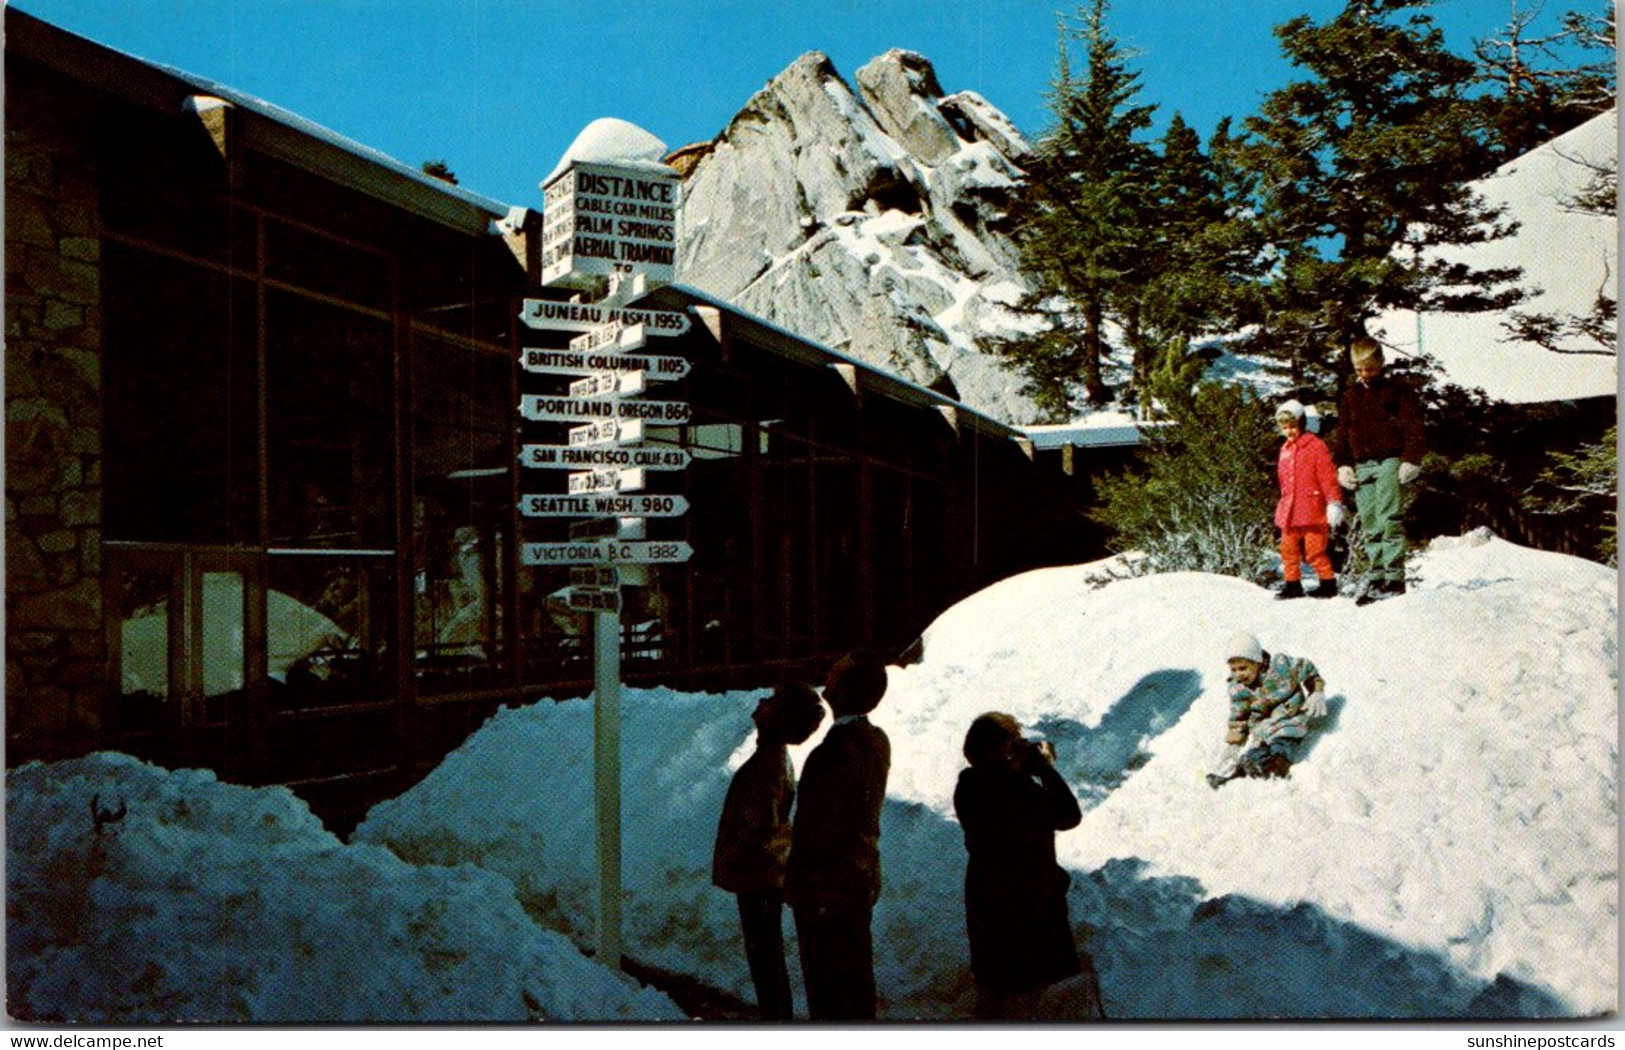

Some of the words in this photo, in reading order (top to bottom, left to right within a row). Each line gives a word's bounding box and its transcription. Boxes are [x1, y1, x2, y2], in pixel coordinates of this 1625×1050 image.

[578, 173, 673, 203] DISTANCE
[575, 198, 611, 215] CABLE
[613, 203, 637, 217] CAR
[639, 205, 675, 221] MILES
[576, 215, 613, 235] PALM
[617, 221, 674, 242] SPRINGS
[574, 236, 617, 260] AERIAL
[619, 242, 676, 265] TRAMWAY
[613, 263, 633, 273] TO
[654, 313, 685, 329] 1955
[527, 351, 584, 368] BRITISH
[588, 355, 650, 371] COLUMBIA
[657, 359, 685, 373] 1105
[618, 402, 663, 419] OREGON
[665, 403, 690, 420] 864
[532, 448, 556, 463] SAN
[663, 451, 684, 466] 431
[641, 497, 674, 512] 980
[532, 546, 601, 560] VICTORIA
[648, 545, 678, 559] 1382
